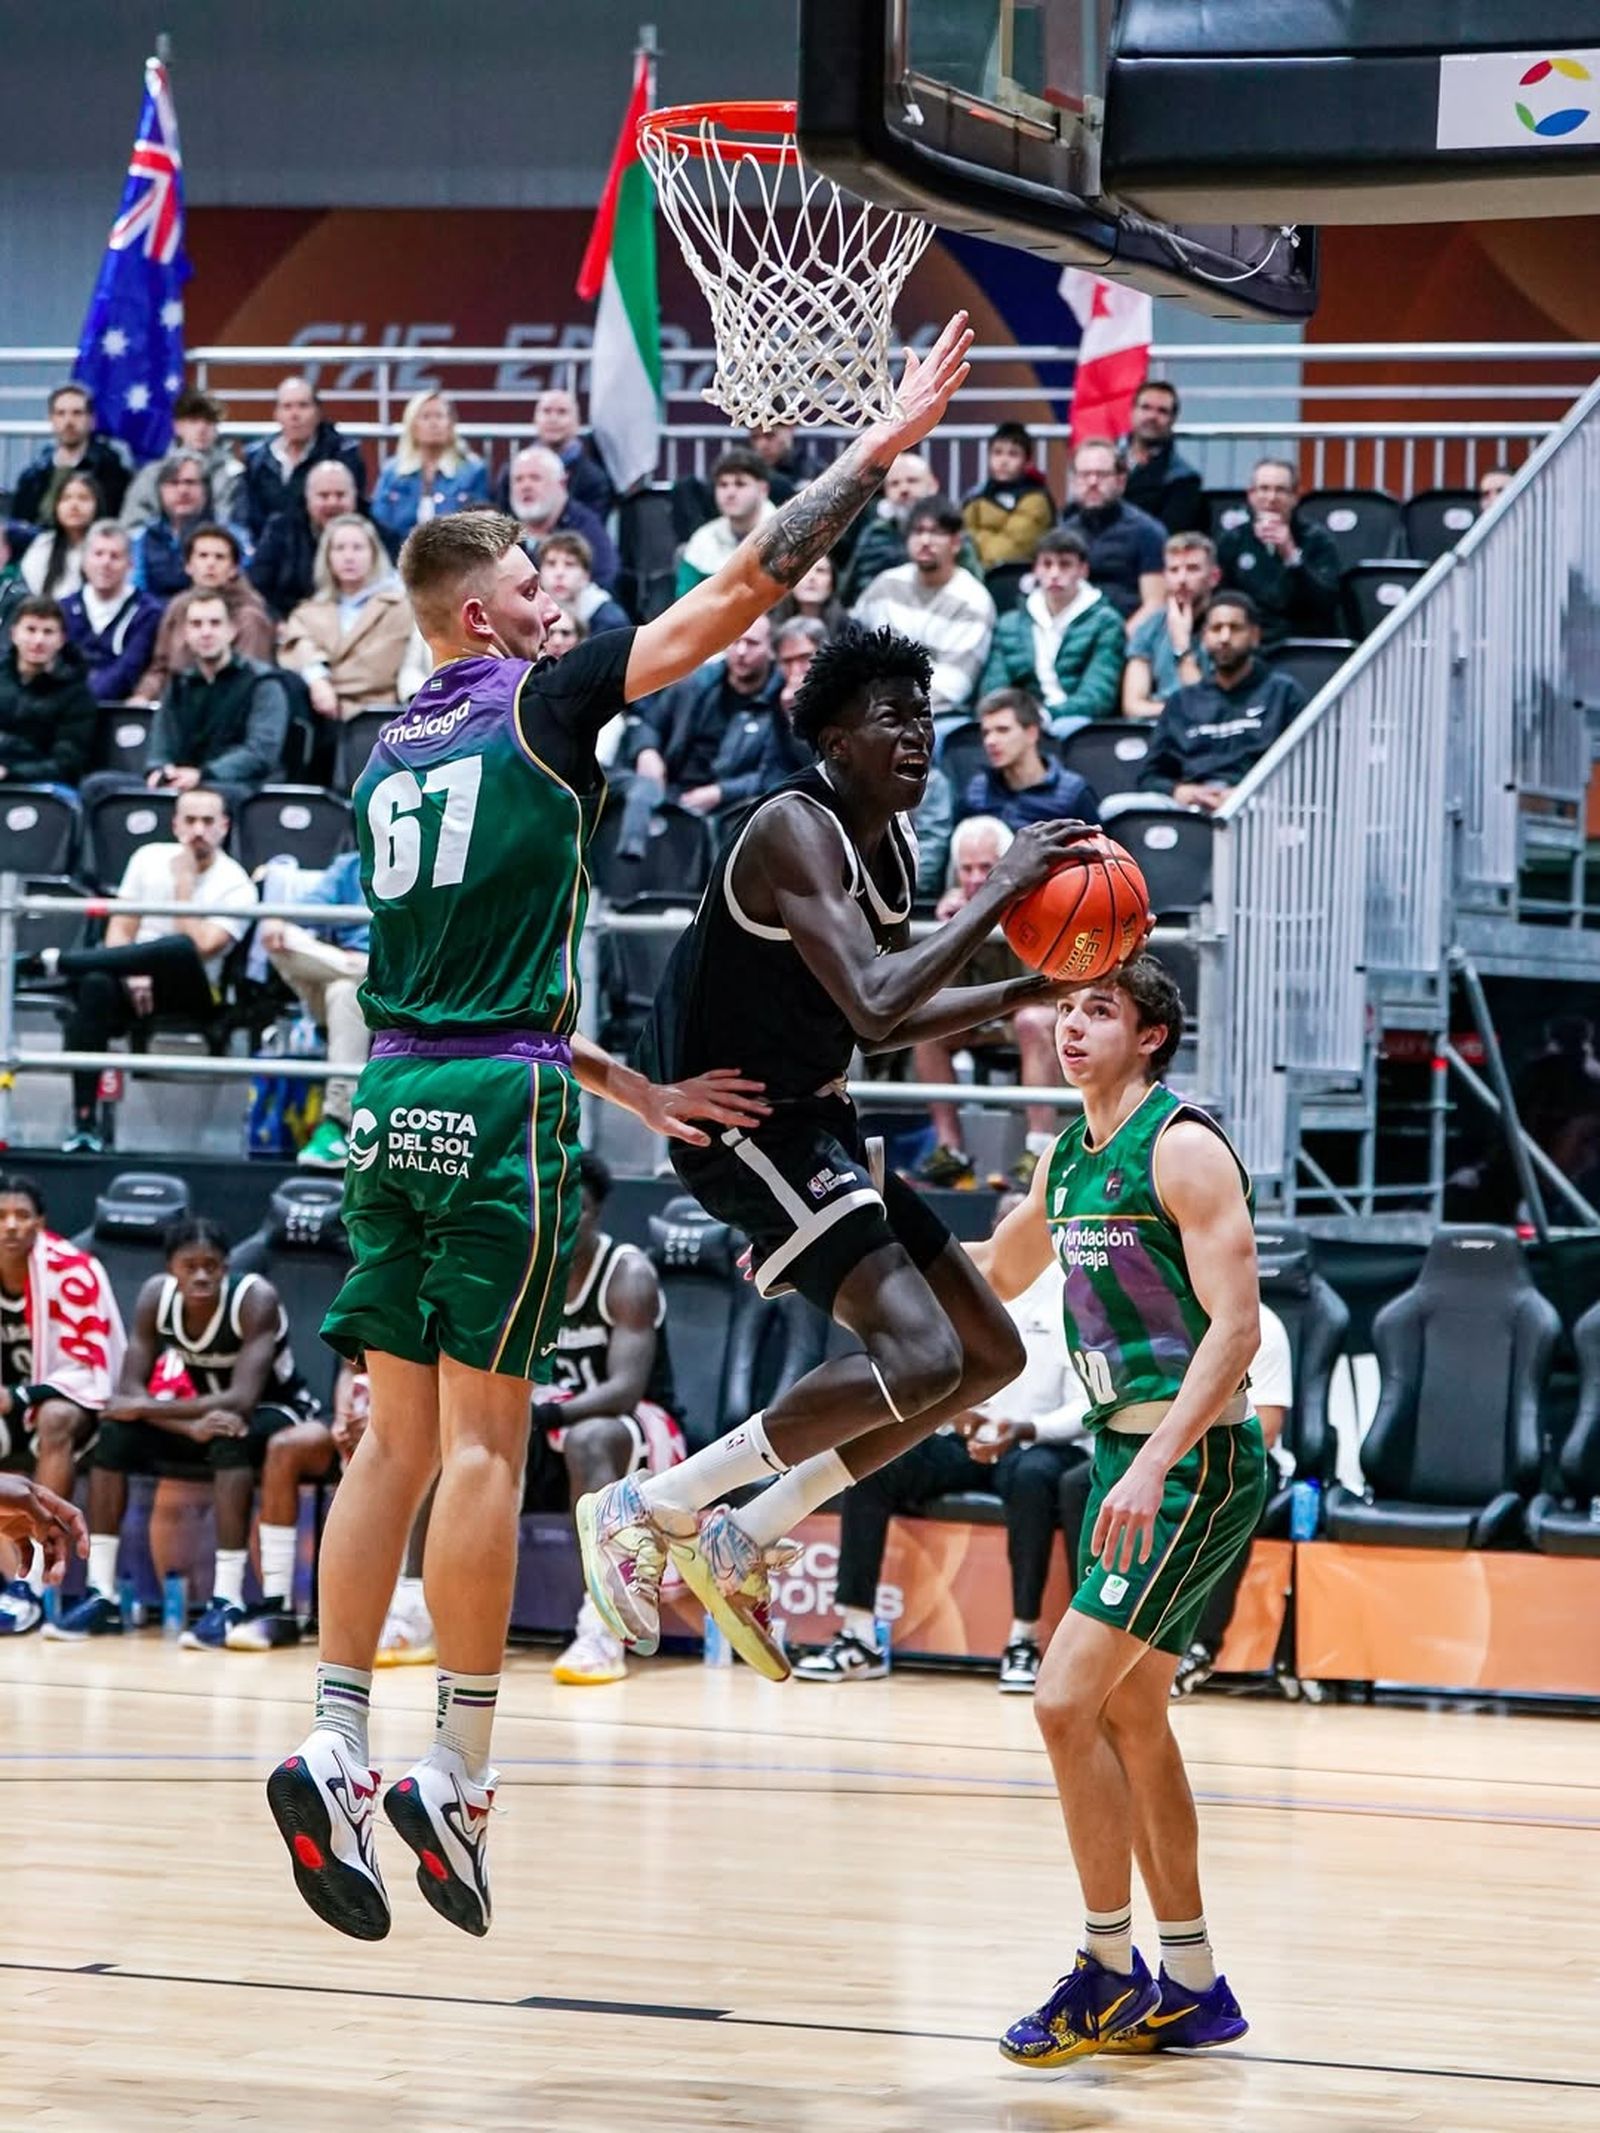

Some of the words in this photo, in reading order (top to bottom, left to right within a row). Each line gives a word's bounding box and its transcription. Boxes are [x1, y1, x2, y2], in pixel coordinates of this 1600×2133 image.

[367, 754, 483, 900] 67
[389, 1107, 477, 1137] COSTA
[388, 1132, 427, 1152] DEL
[431, 1136, 474, 1159] SOL
[388, 1151, 470, 1179] MÁLAGA
